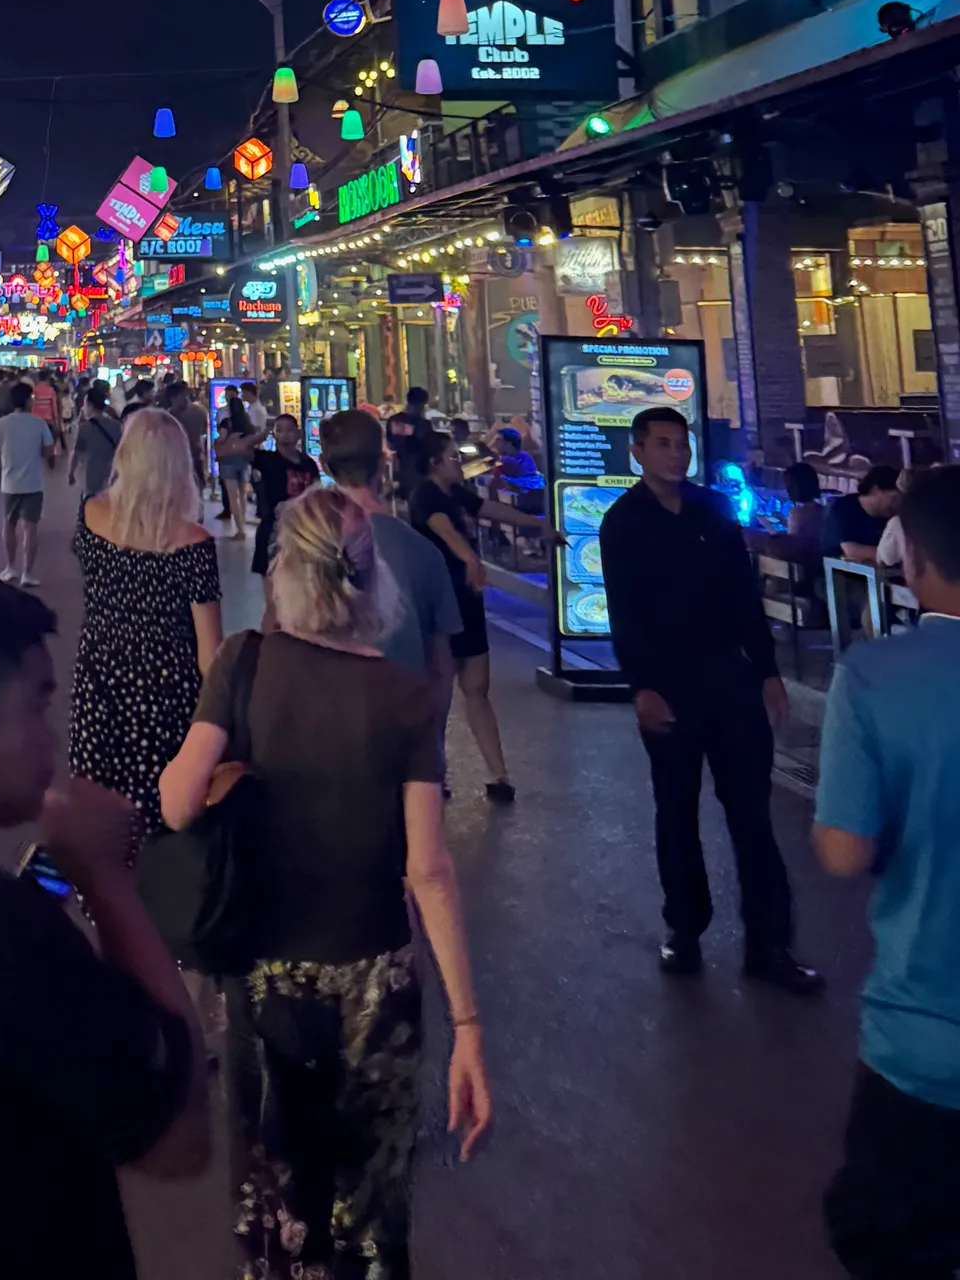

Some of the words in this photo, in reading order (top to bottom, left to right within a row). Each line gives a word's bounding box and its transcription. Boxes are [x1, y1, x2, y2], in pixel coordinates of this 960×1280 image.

[445, 0, 566, 46] EMPLE
[477, 45, 530, 63] Club
[109, 198, 147, 229] TEMPLE
[139, 239, 165, 256] A/C
[167, 239, 202, 254] ROO
[581, 343, 619, 354] SPECIAL
[618, 346, 670, 356] PROMOTION
